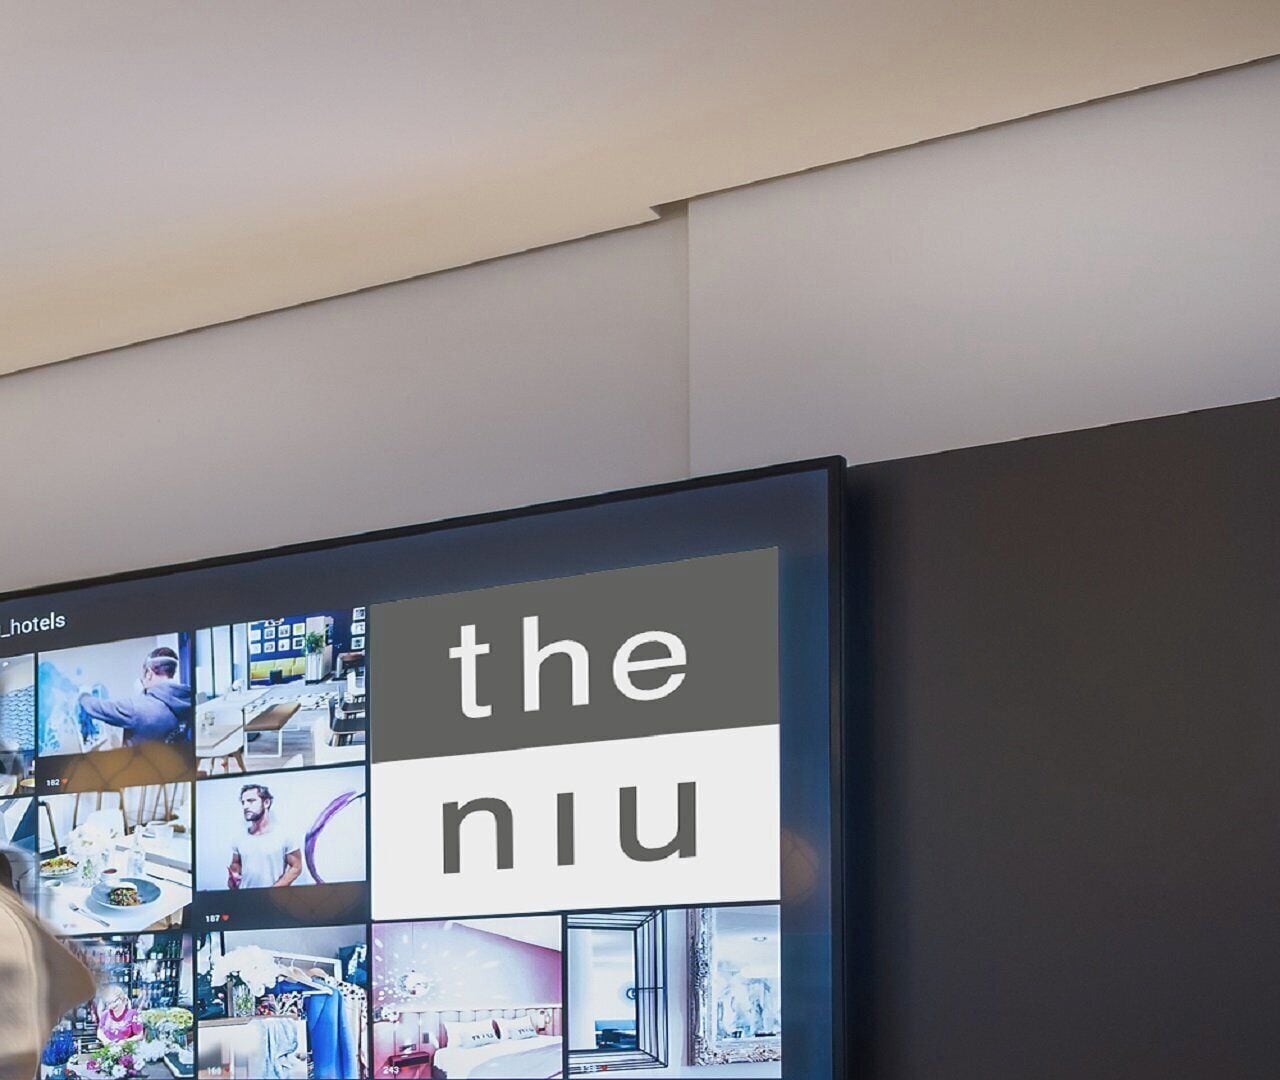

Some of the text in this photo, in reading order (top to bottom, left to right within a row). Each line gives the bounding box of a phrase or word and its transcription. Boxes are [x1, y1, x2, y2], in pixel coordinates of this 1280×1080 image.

[448, 615, 688, 719] the
[442, 780, 697, 875] niu
[205, 914, 220, 923] 187
[383, 1066, 400, 1075] 243
